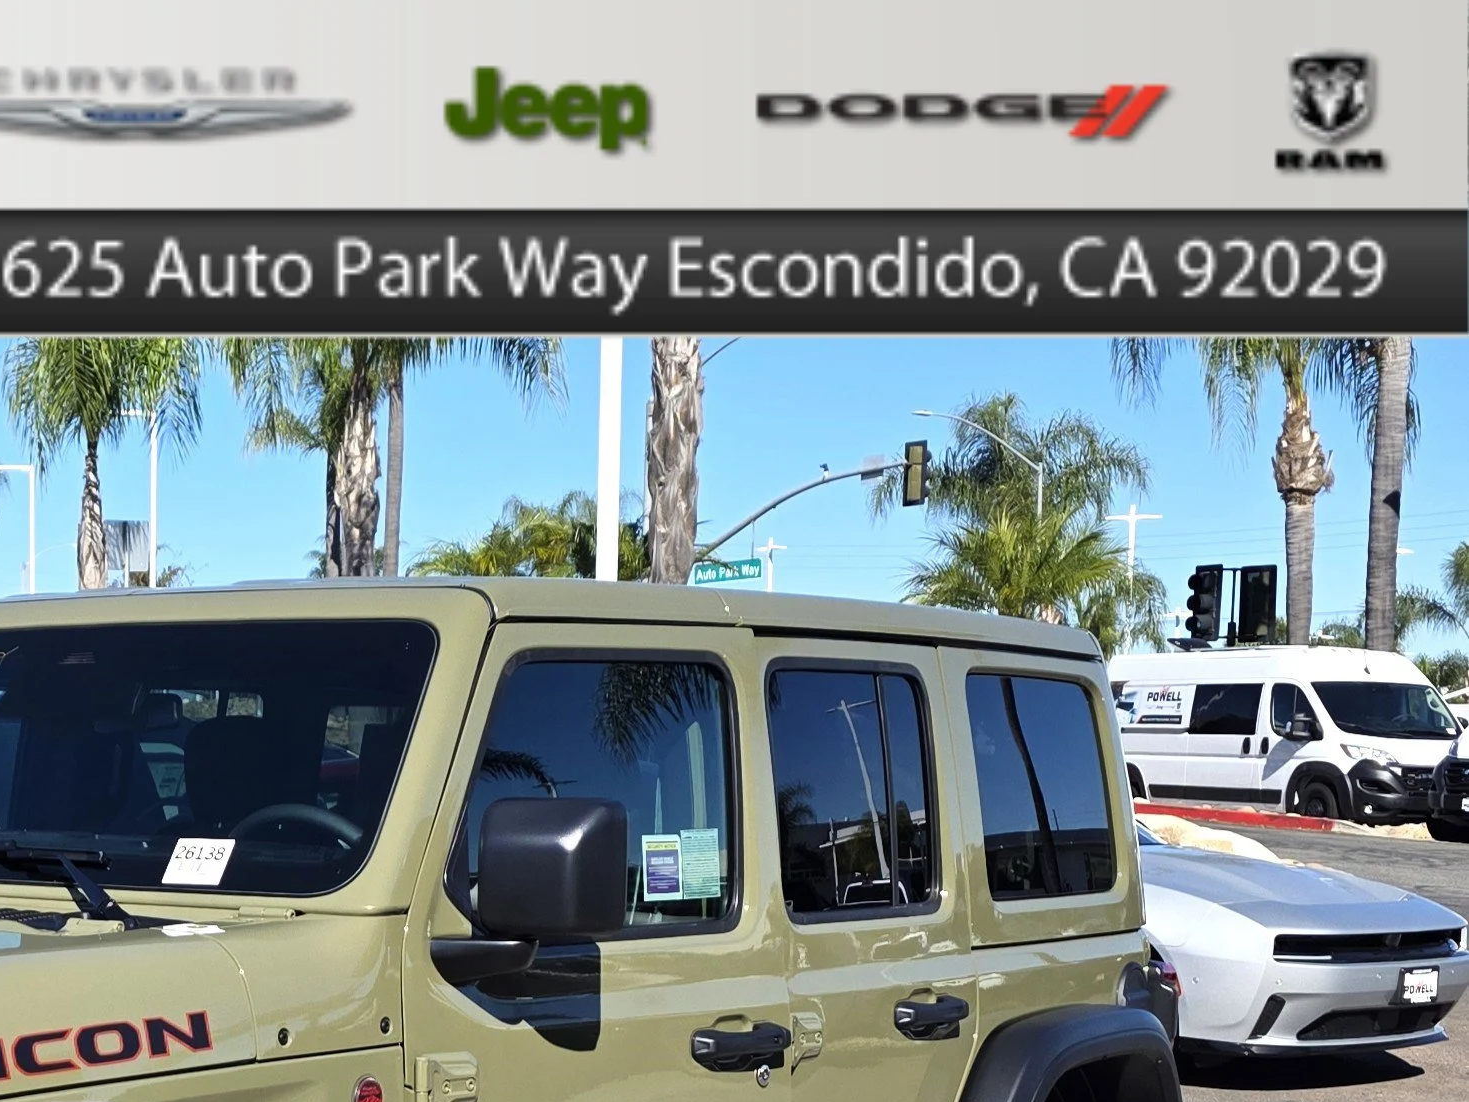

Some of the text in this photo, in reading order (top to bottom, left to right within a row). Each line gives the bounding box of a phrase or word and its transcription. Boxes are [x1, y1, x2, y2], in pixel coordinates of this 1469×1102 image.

[695, 563, 760, 581] Auto Park Way
[1146, 691, 1182, 702] POWELL
[175, 845, 226, 861] 26138
